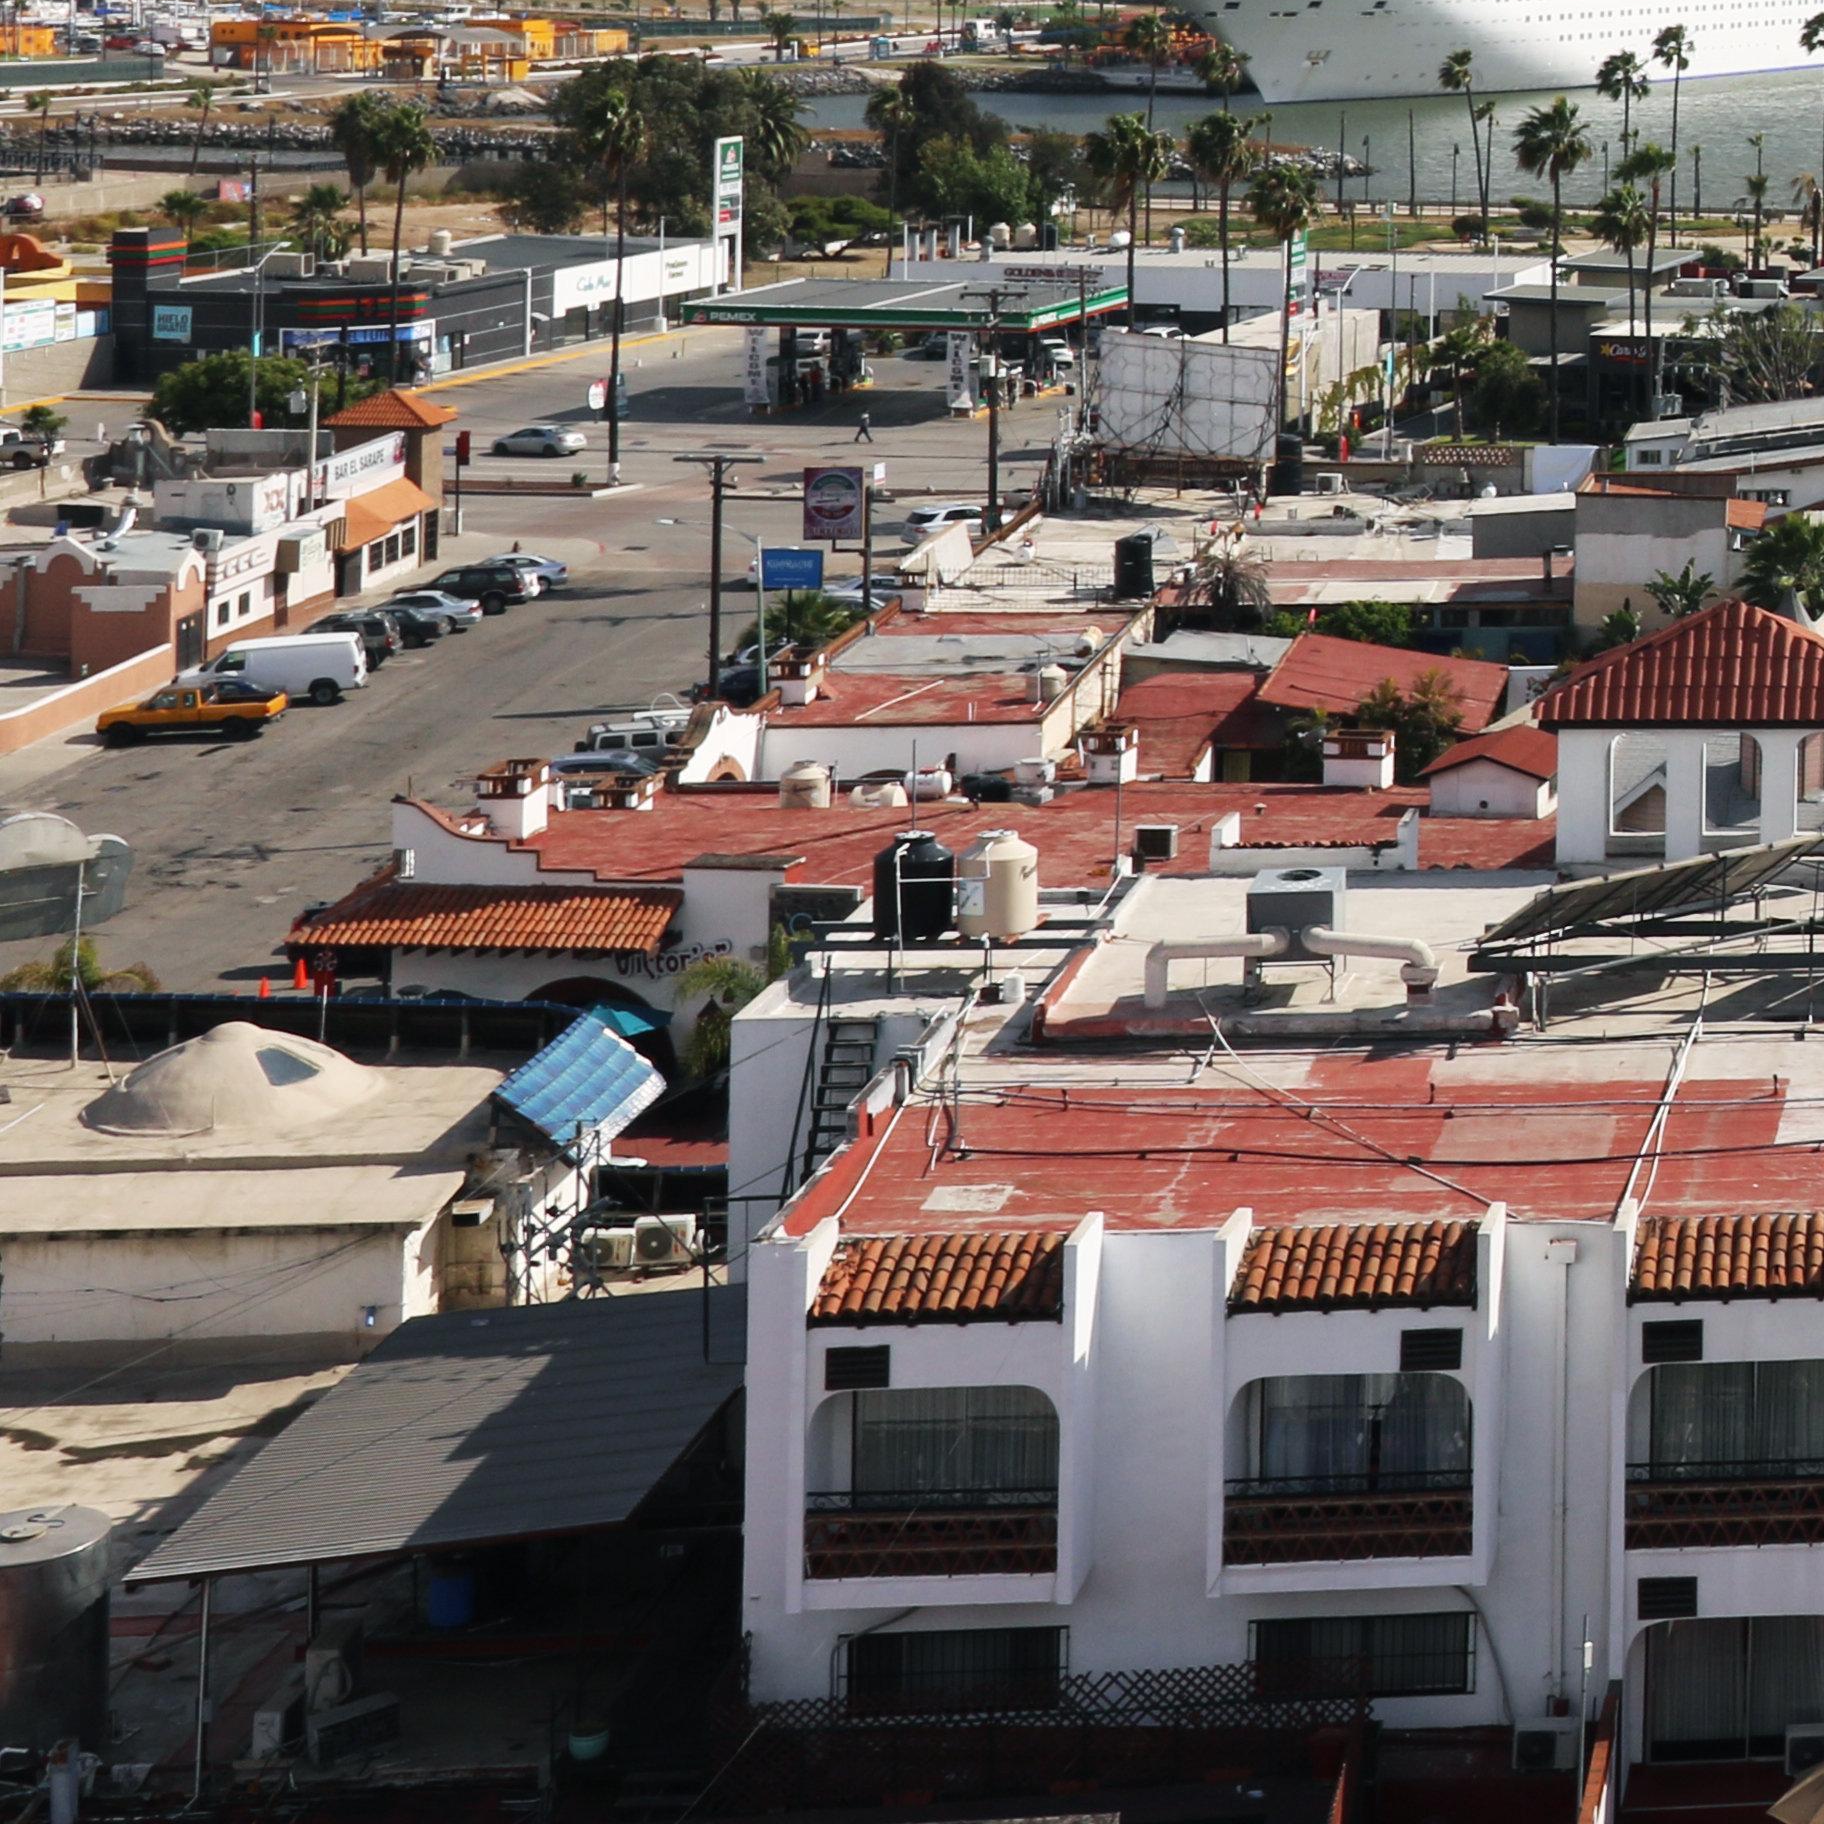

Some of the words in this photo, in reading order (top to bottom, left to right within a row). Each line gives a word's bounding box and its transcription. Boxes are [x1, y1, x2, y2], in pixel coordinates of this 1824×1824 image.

[710, 312, 757, 322] PEMEX
[334, 462, 349, 480] BAR
[349, 461, 359, 475] EL
[359, 449, 384, 472] SARAPE
